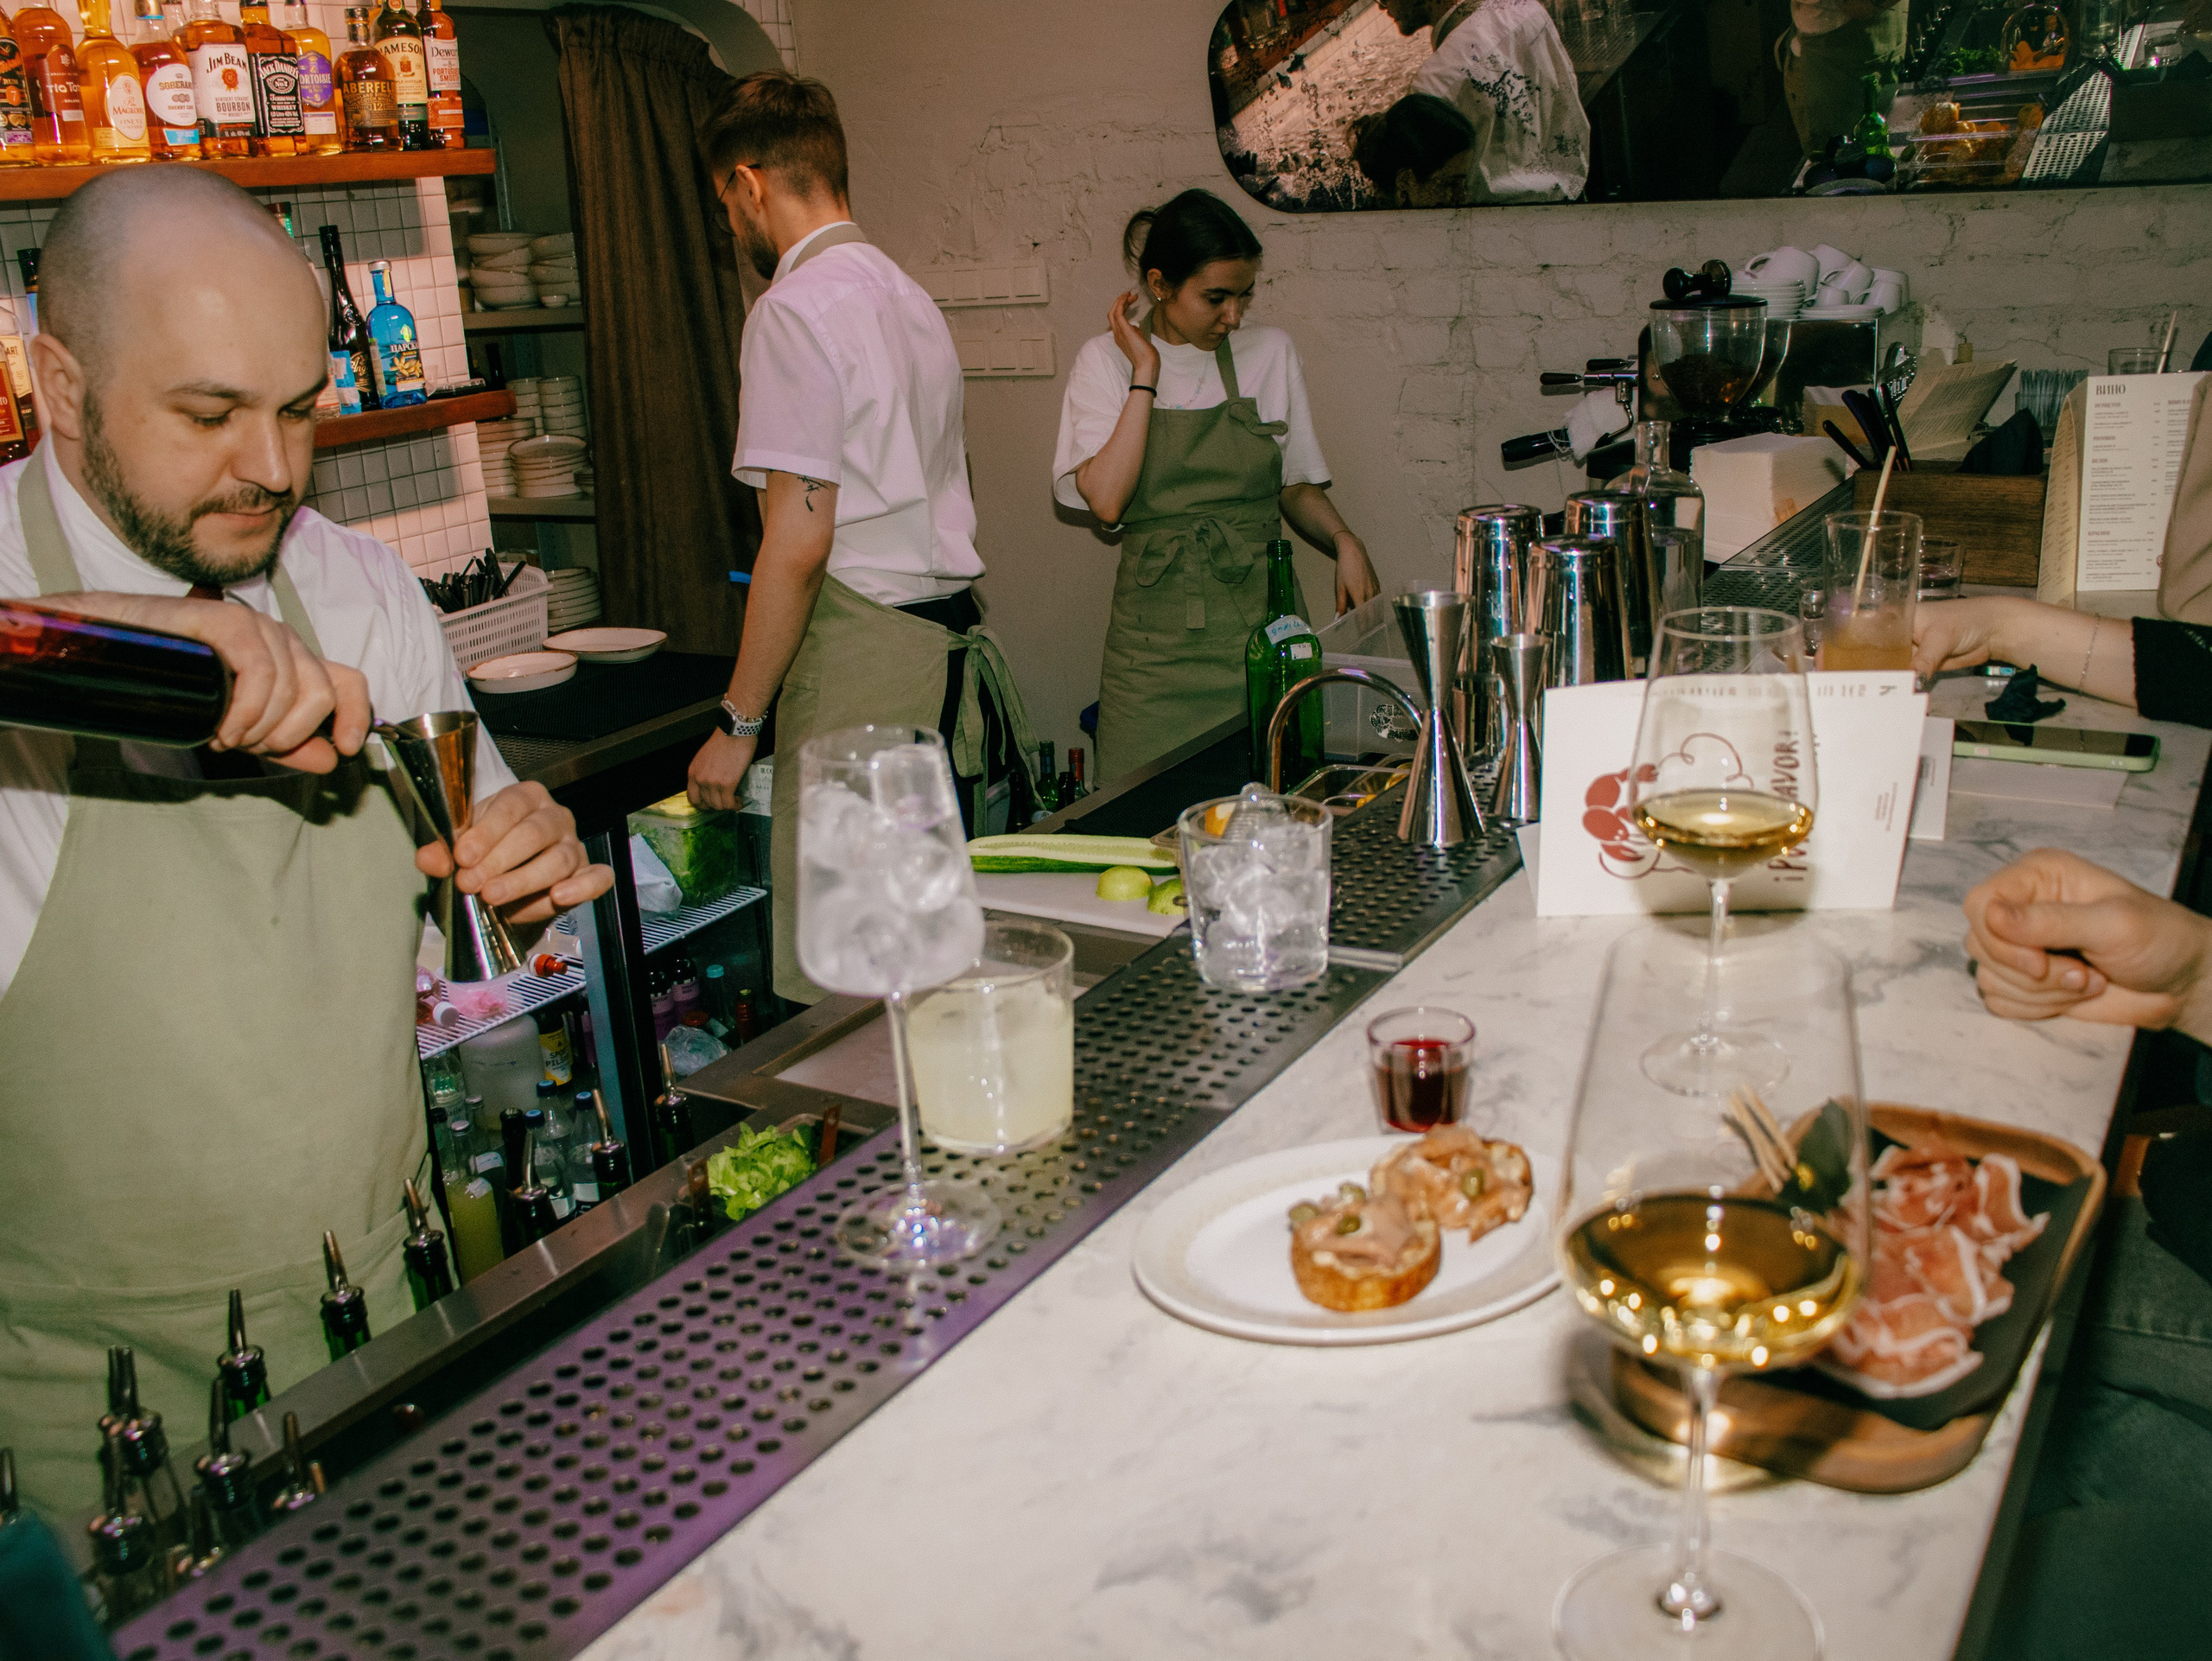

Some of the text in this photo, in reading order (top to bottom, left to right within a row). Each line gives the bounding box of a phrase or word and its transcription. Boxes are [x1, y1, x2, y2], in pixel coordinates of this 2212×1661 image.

[207, 52, 248, 73] JIM BEAM
[259, 63, 275, 79] JACK
[10, 90, 16, 101] 7
[216, 101, 251, 112] BOURBON
[372, 102, 383, 111] 12
